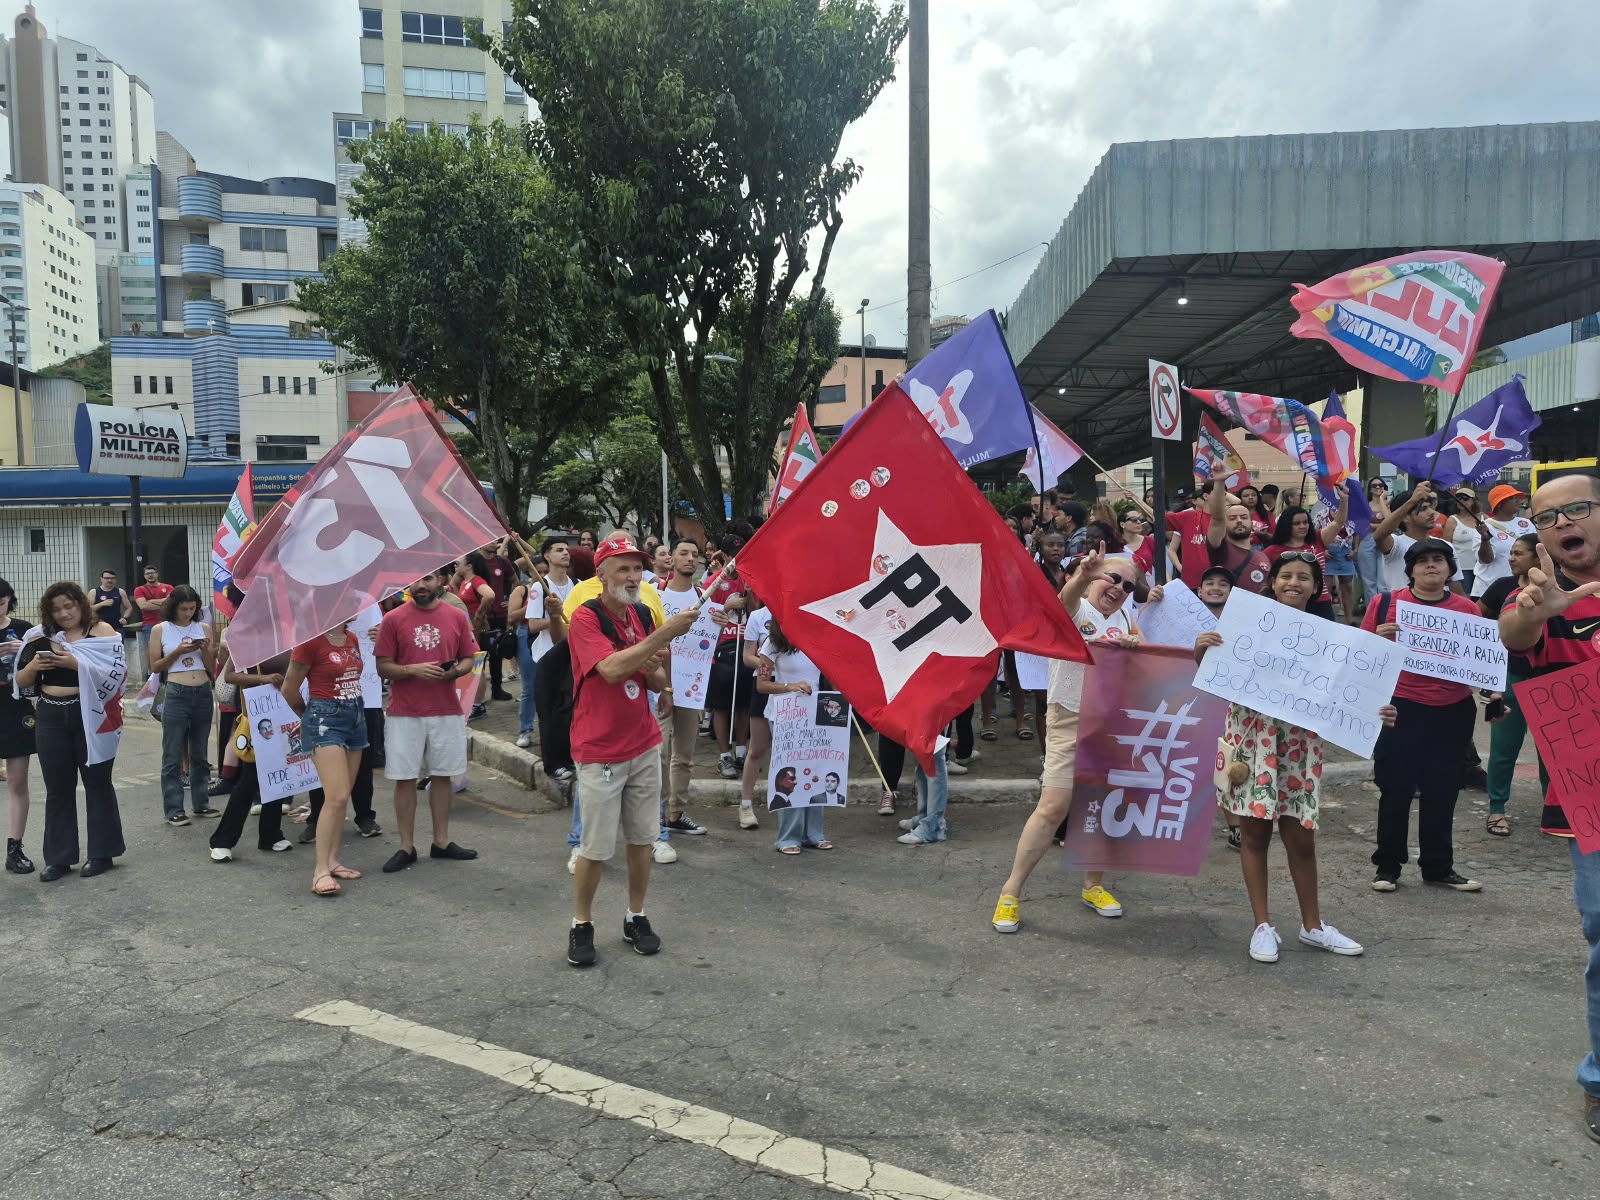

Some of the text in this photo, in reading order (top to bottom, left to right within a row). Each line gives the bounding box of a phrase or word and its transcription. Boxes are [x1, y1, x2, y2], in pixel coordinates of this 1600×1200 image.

[100, 437, 180, 455] MILITAR
[1448, 430, 1505, 456] 13
[115, 452, 146, 460] MINAS
[148, 454, 180, 462] GERAIS
[859, 552, 972, 652] PT
[1401, 609, 1448, 632] DEFENDER
[1452, 619, 1459, 634] A
[1409, 633, 1460, 655] ORGANIZAR
[1464, 645, 1471, 657] A
[1475, 646, 1506, 666] RAIVA
[1437, 663, 1458, 677] CONTRA
[1460, 668, 1465, 678] O
[1467, 670, 1499, 686] FASCISMO
[1529, 665, 1600, 717] POR
[776, 698, 792, 714] LER
[786, 748, 845, 763] BOLSONARISTA
[267, 761, 310, 786] PEDE JU
[1155, 756, 1199, 841] VOTE
